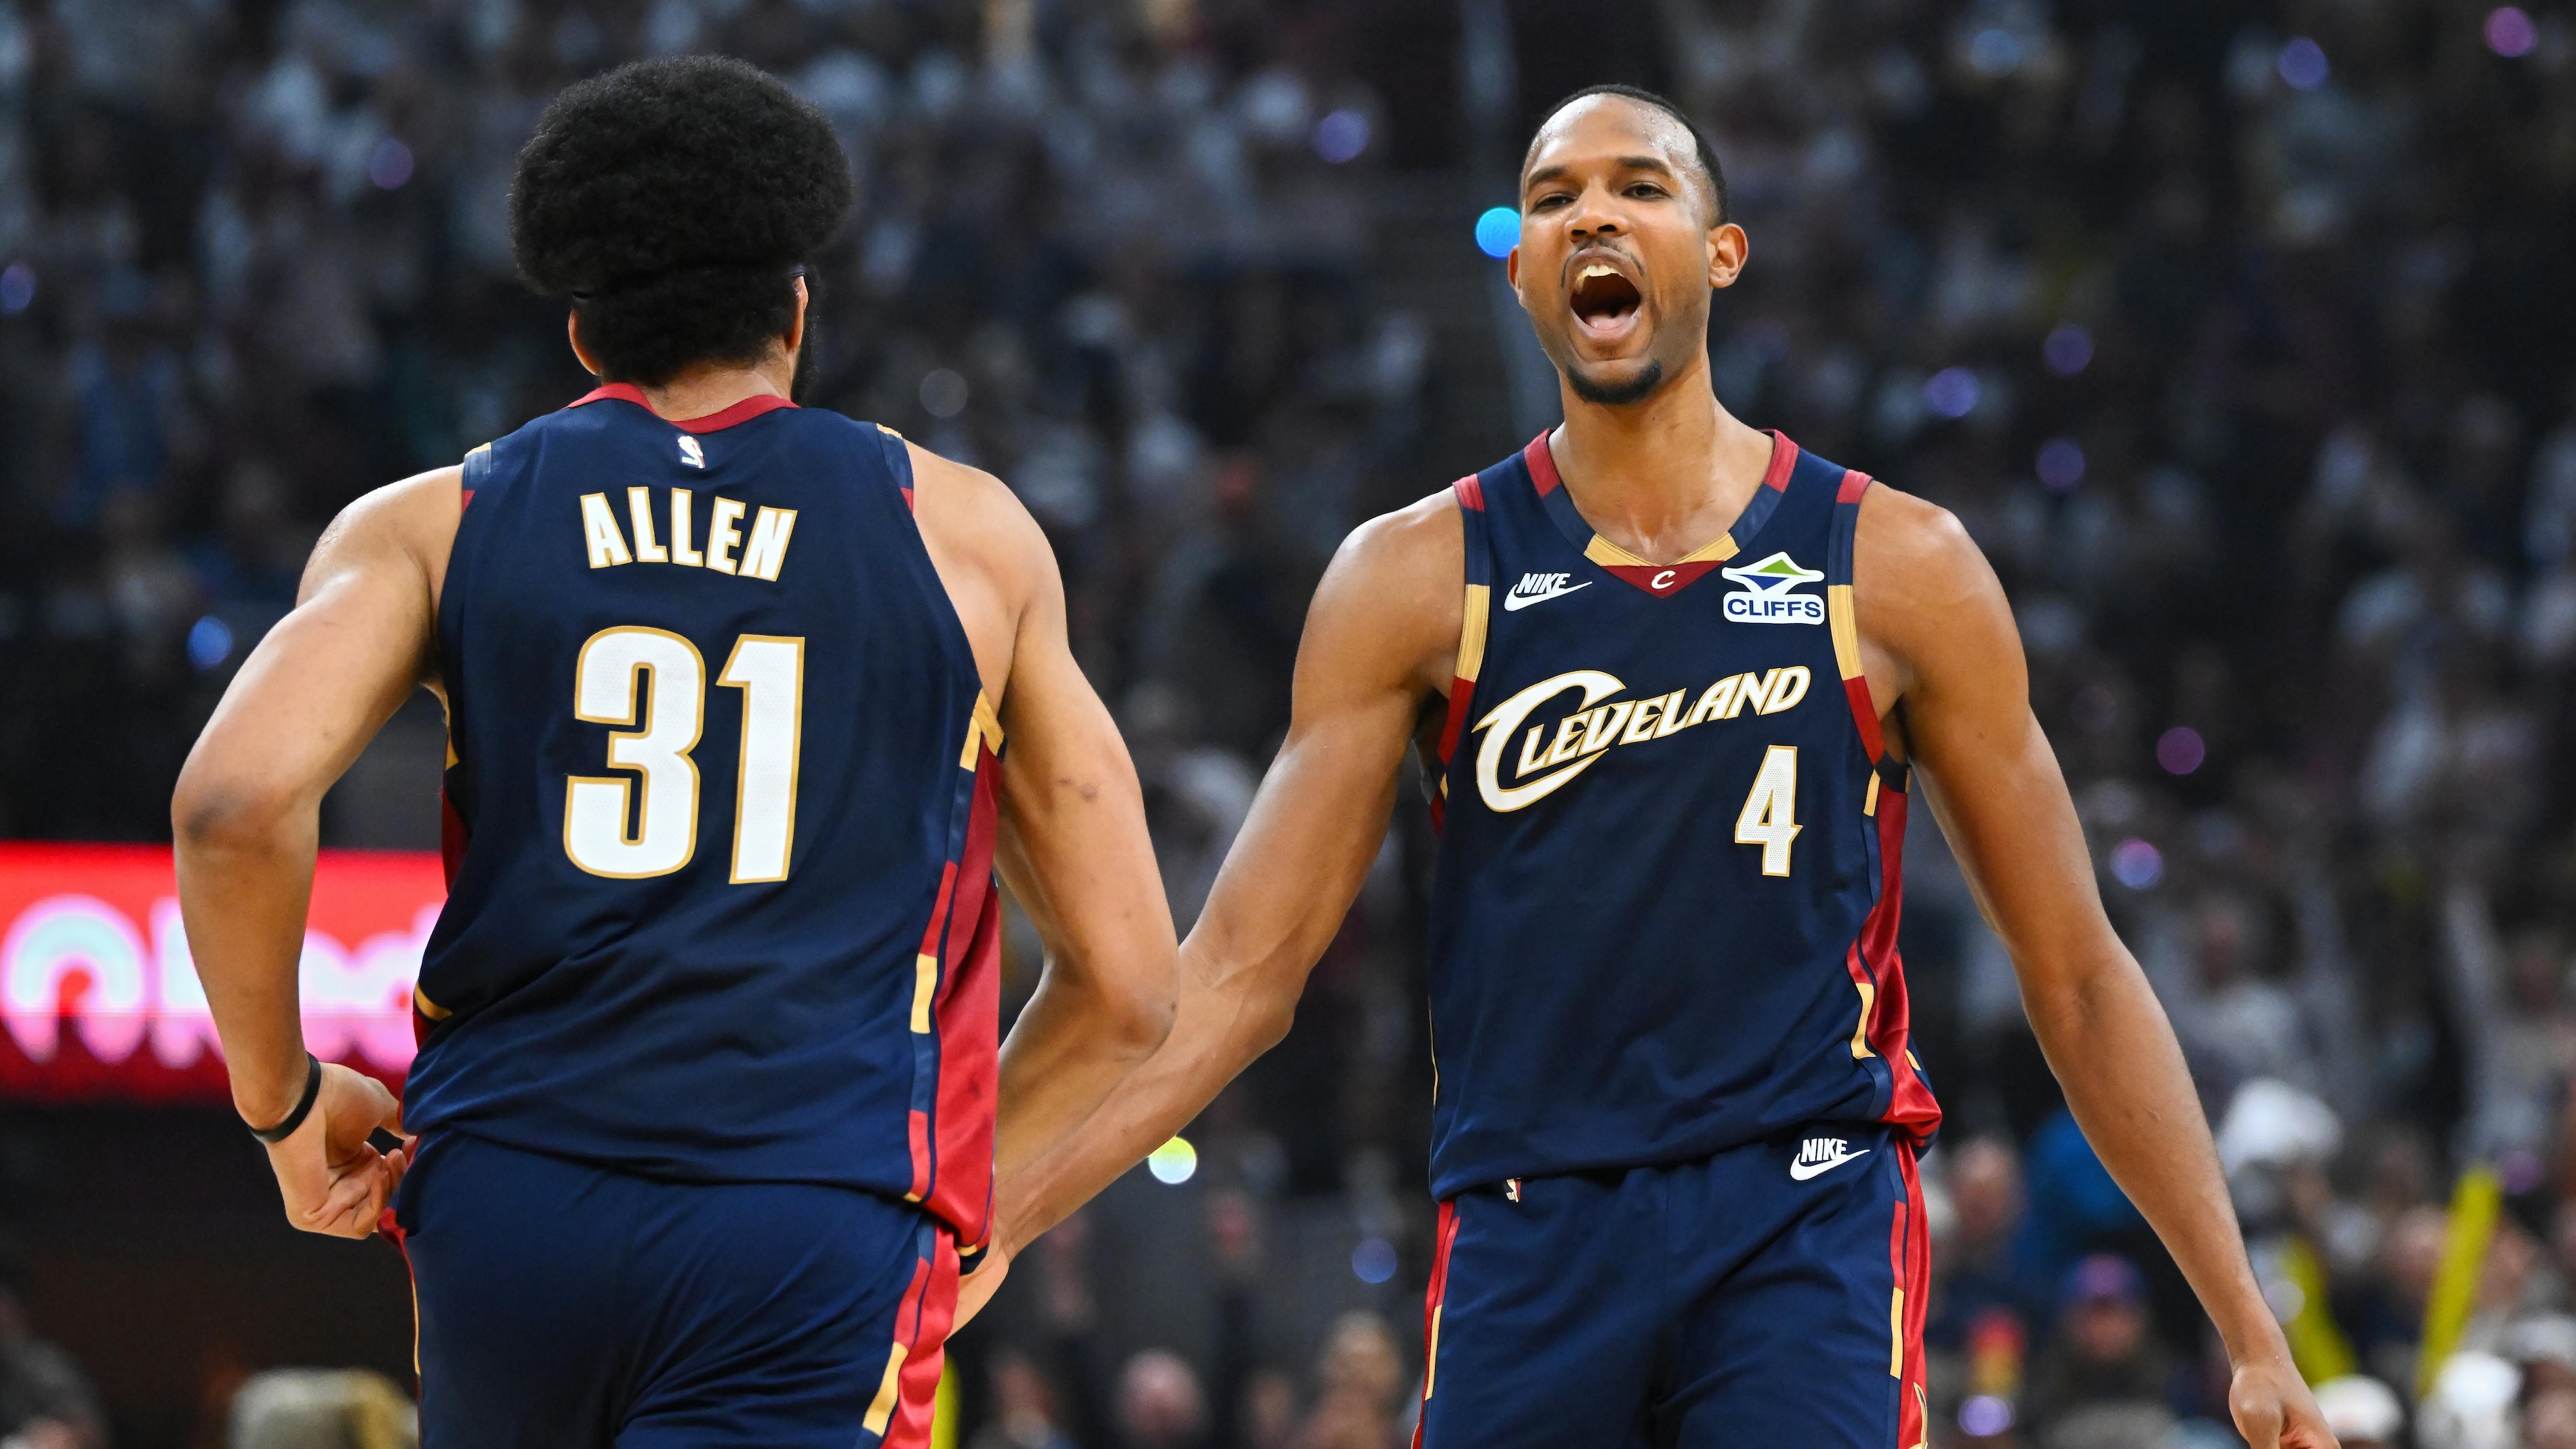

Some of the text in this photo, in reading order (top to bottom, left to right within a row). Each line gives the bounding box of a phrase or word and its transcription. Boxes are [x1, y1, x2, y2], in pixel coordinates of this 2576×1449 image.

[580, 486, 797, 581] ALLEN
[1516, 573, 1571, 594] NIKE
[1651, 570, 1676, 589] C
[1727, 599, 1821, 618] CLIFFS
[563, 625, 805, 884] 31
[1472, 666, 1811, 812] CLEVELAND
[1735, 745, 1803, 877] 4
[1800, 1138, 1847, 1163] NIKE
